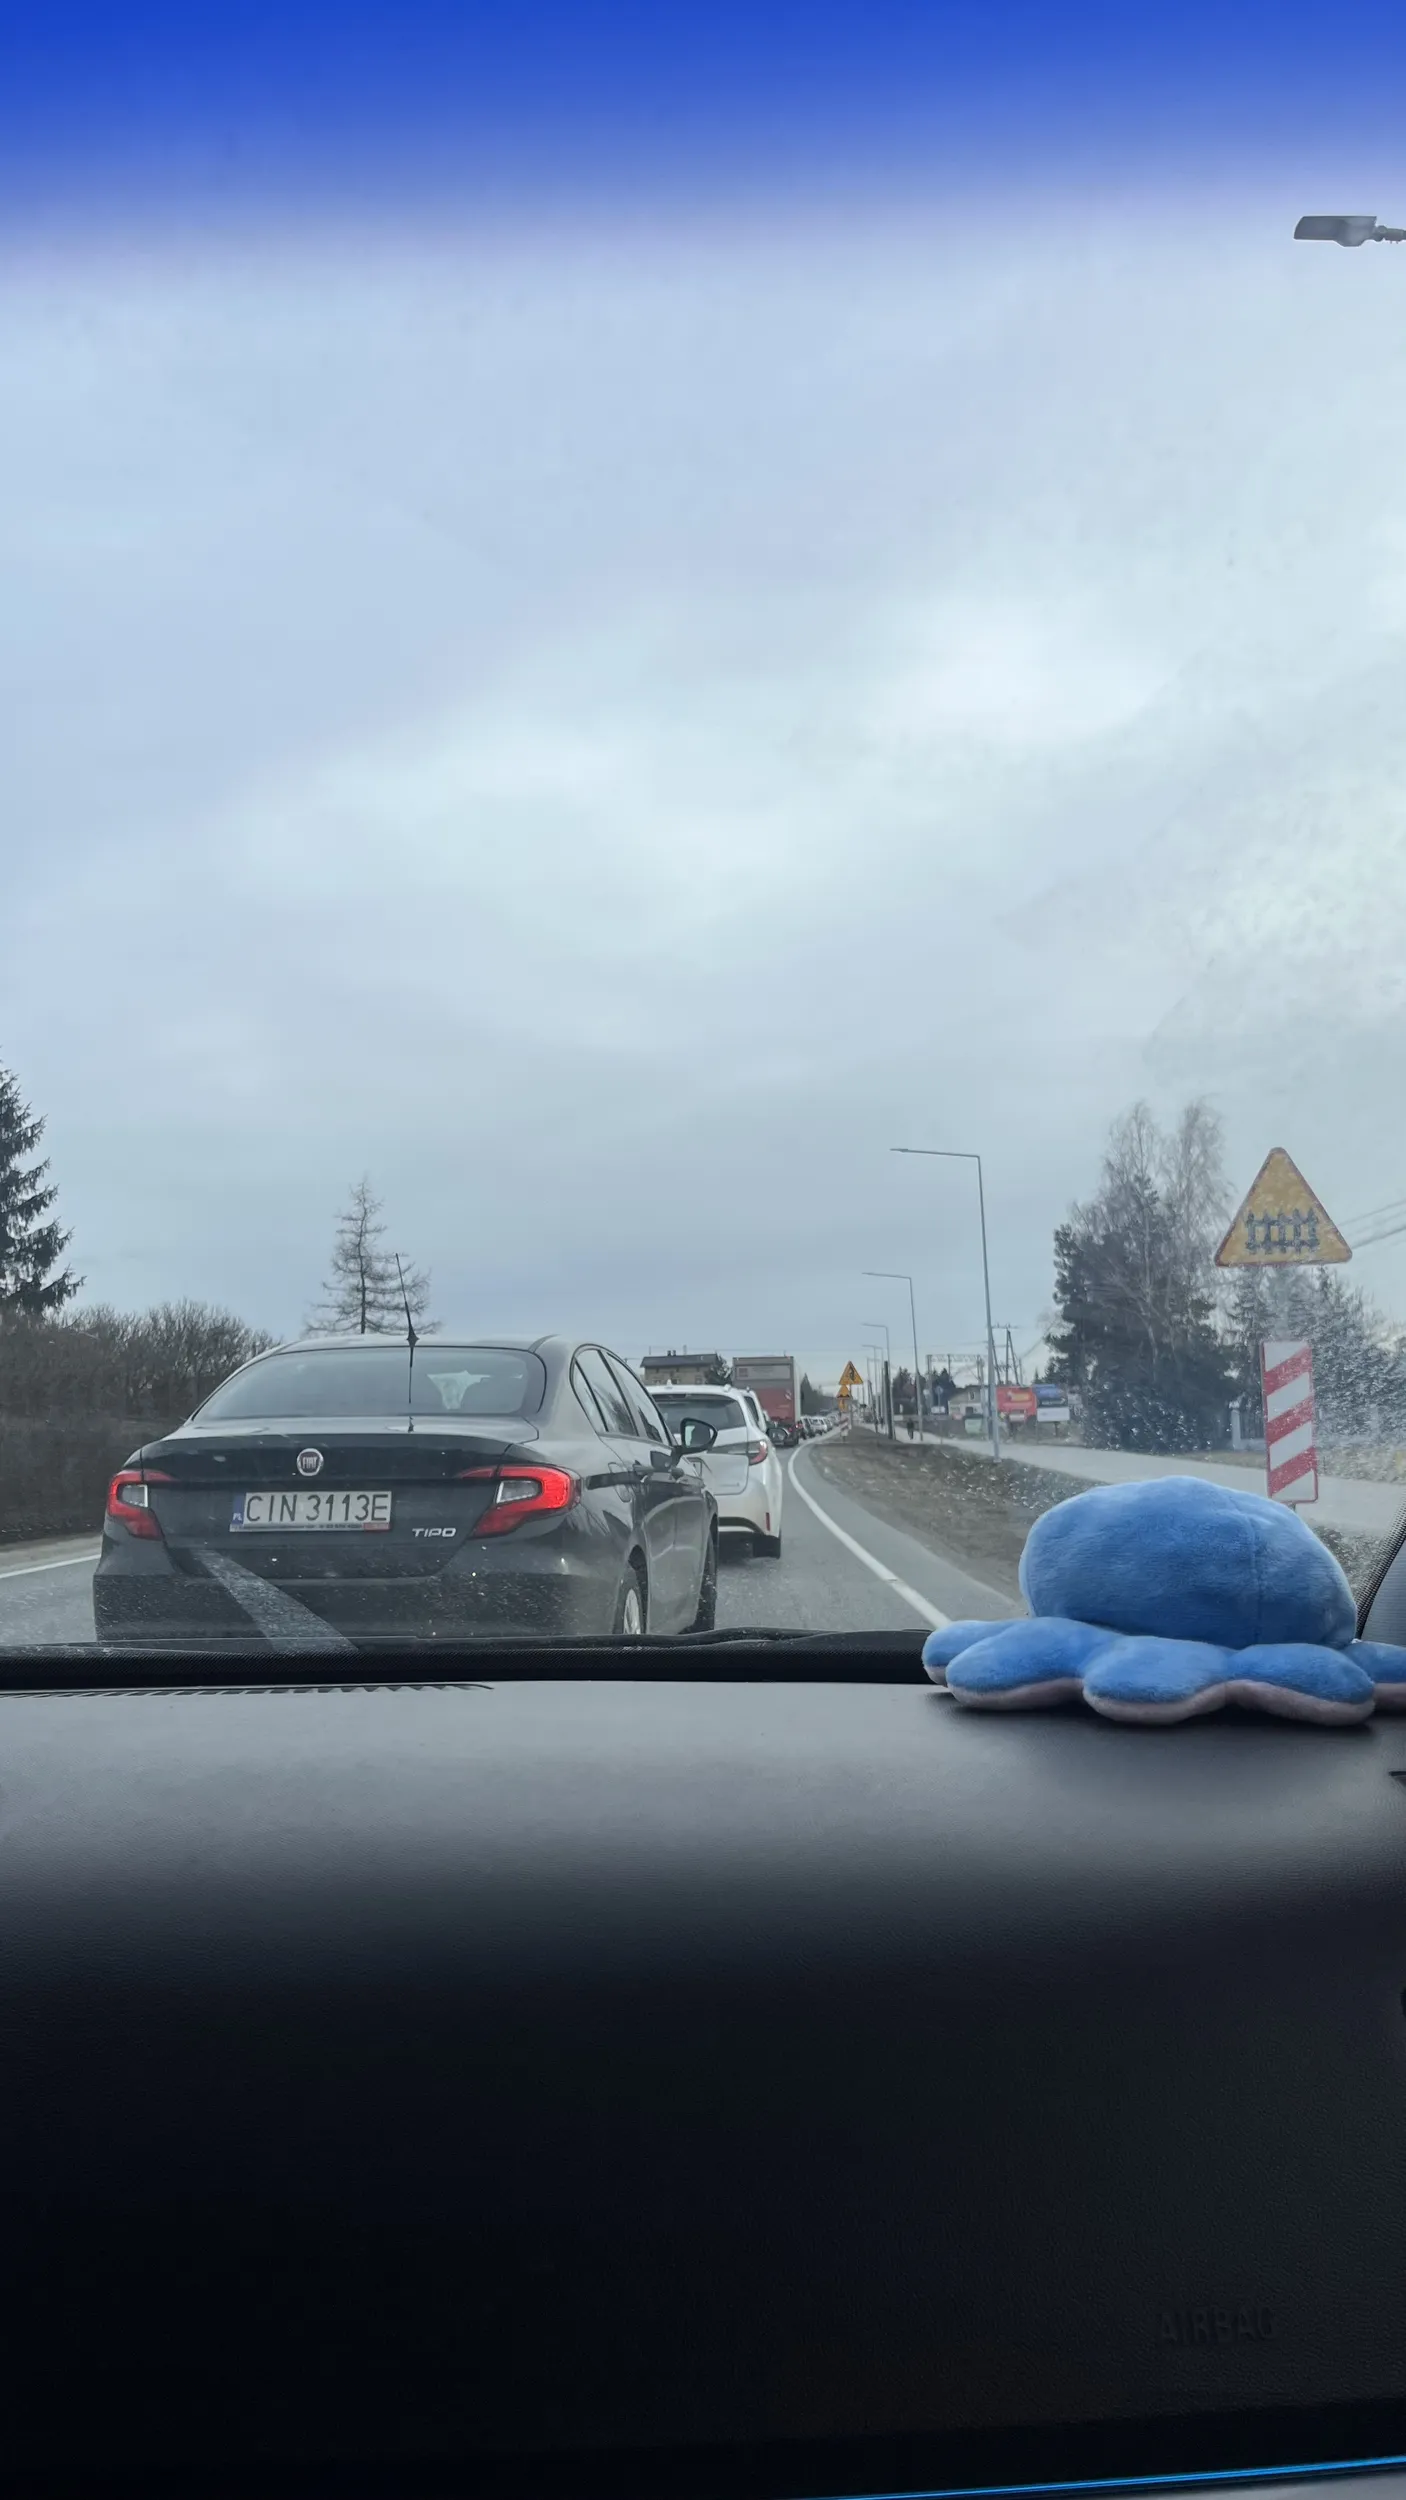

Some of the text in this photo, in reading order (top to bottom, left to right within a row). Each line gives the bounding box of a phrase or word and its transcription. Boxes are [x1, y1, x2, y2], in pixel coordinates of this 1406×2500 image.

[302, 1456, 318, 1469] FIAT
[411, 1527, 457, 1538] TIPO
[1157, 2306, 1276, 2344] AIRBAG
